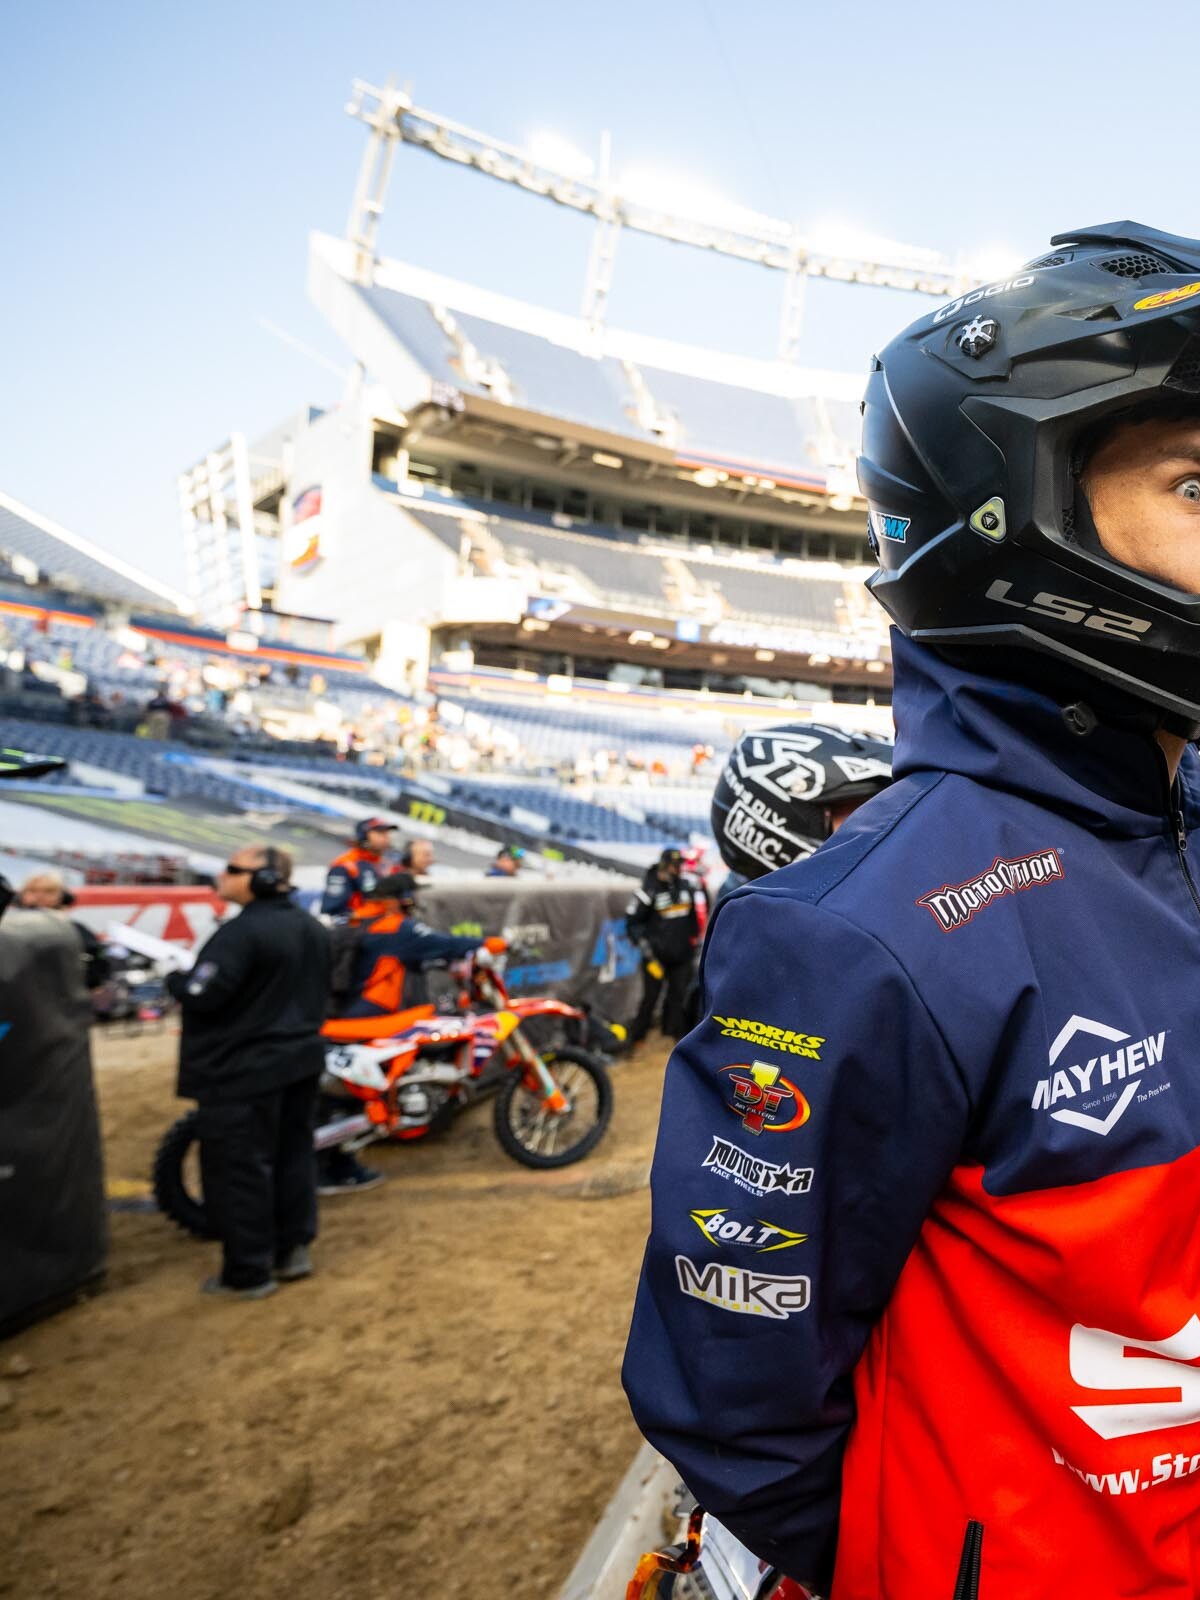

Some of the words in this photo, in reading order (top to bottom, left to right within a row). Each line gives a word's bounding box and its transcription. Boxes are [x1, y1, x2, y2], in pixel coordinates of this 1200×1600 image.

[985, 579, 1153, 642] LS2
[712, 1016, 826, 1049] WORKS
[720, 1028, 821, 1060] CONNECTION
[1031, 1031, 1166, 1110] MAYHEW
[710, 1166, 731, 1180] RACE
[733, 1177, 764, 1197] WHEELS
[704, 1213, 779, 1244] BOLT
